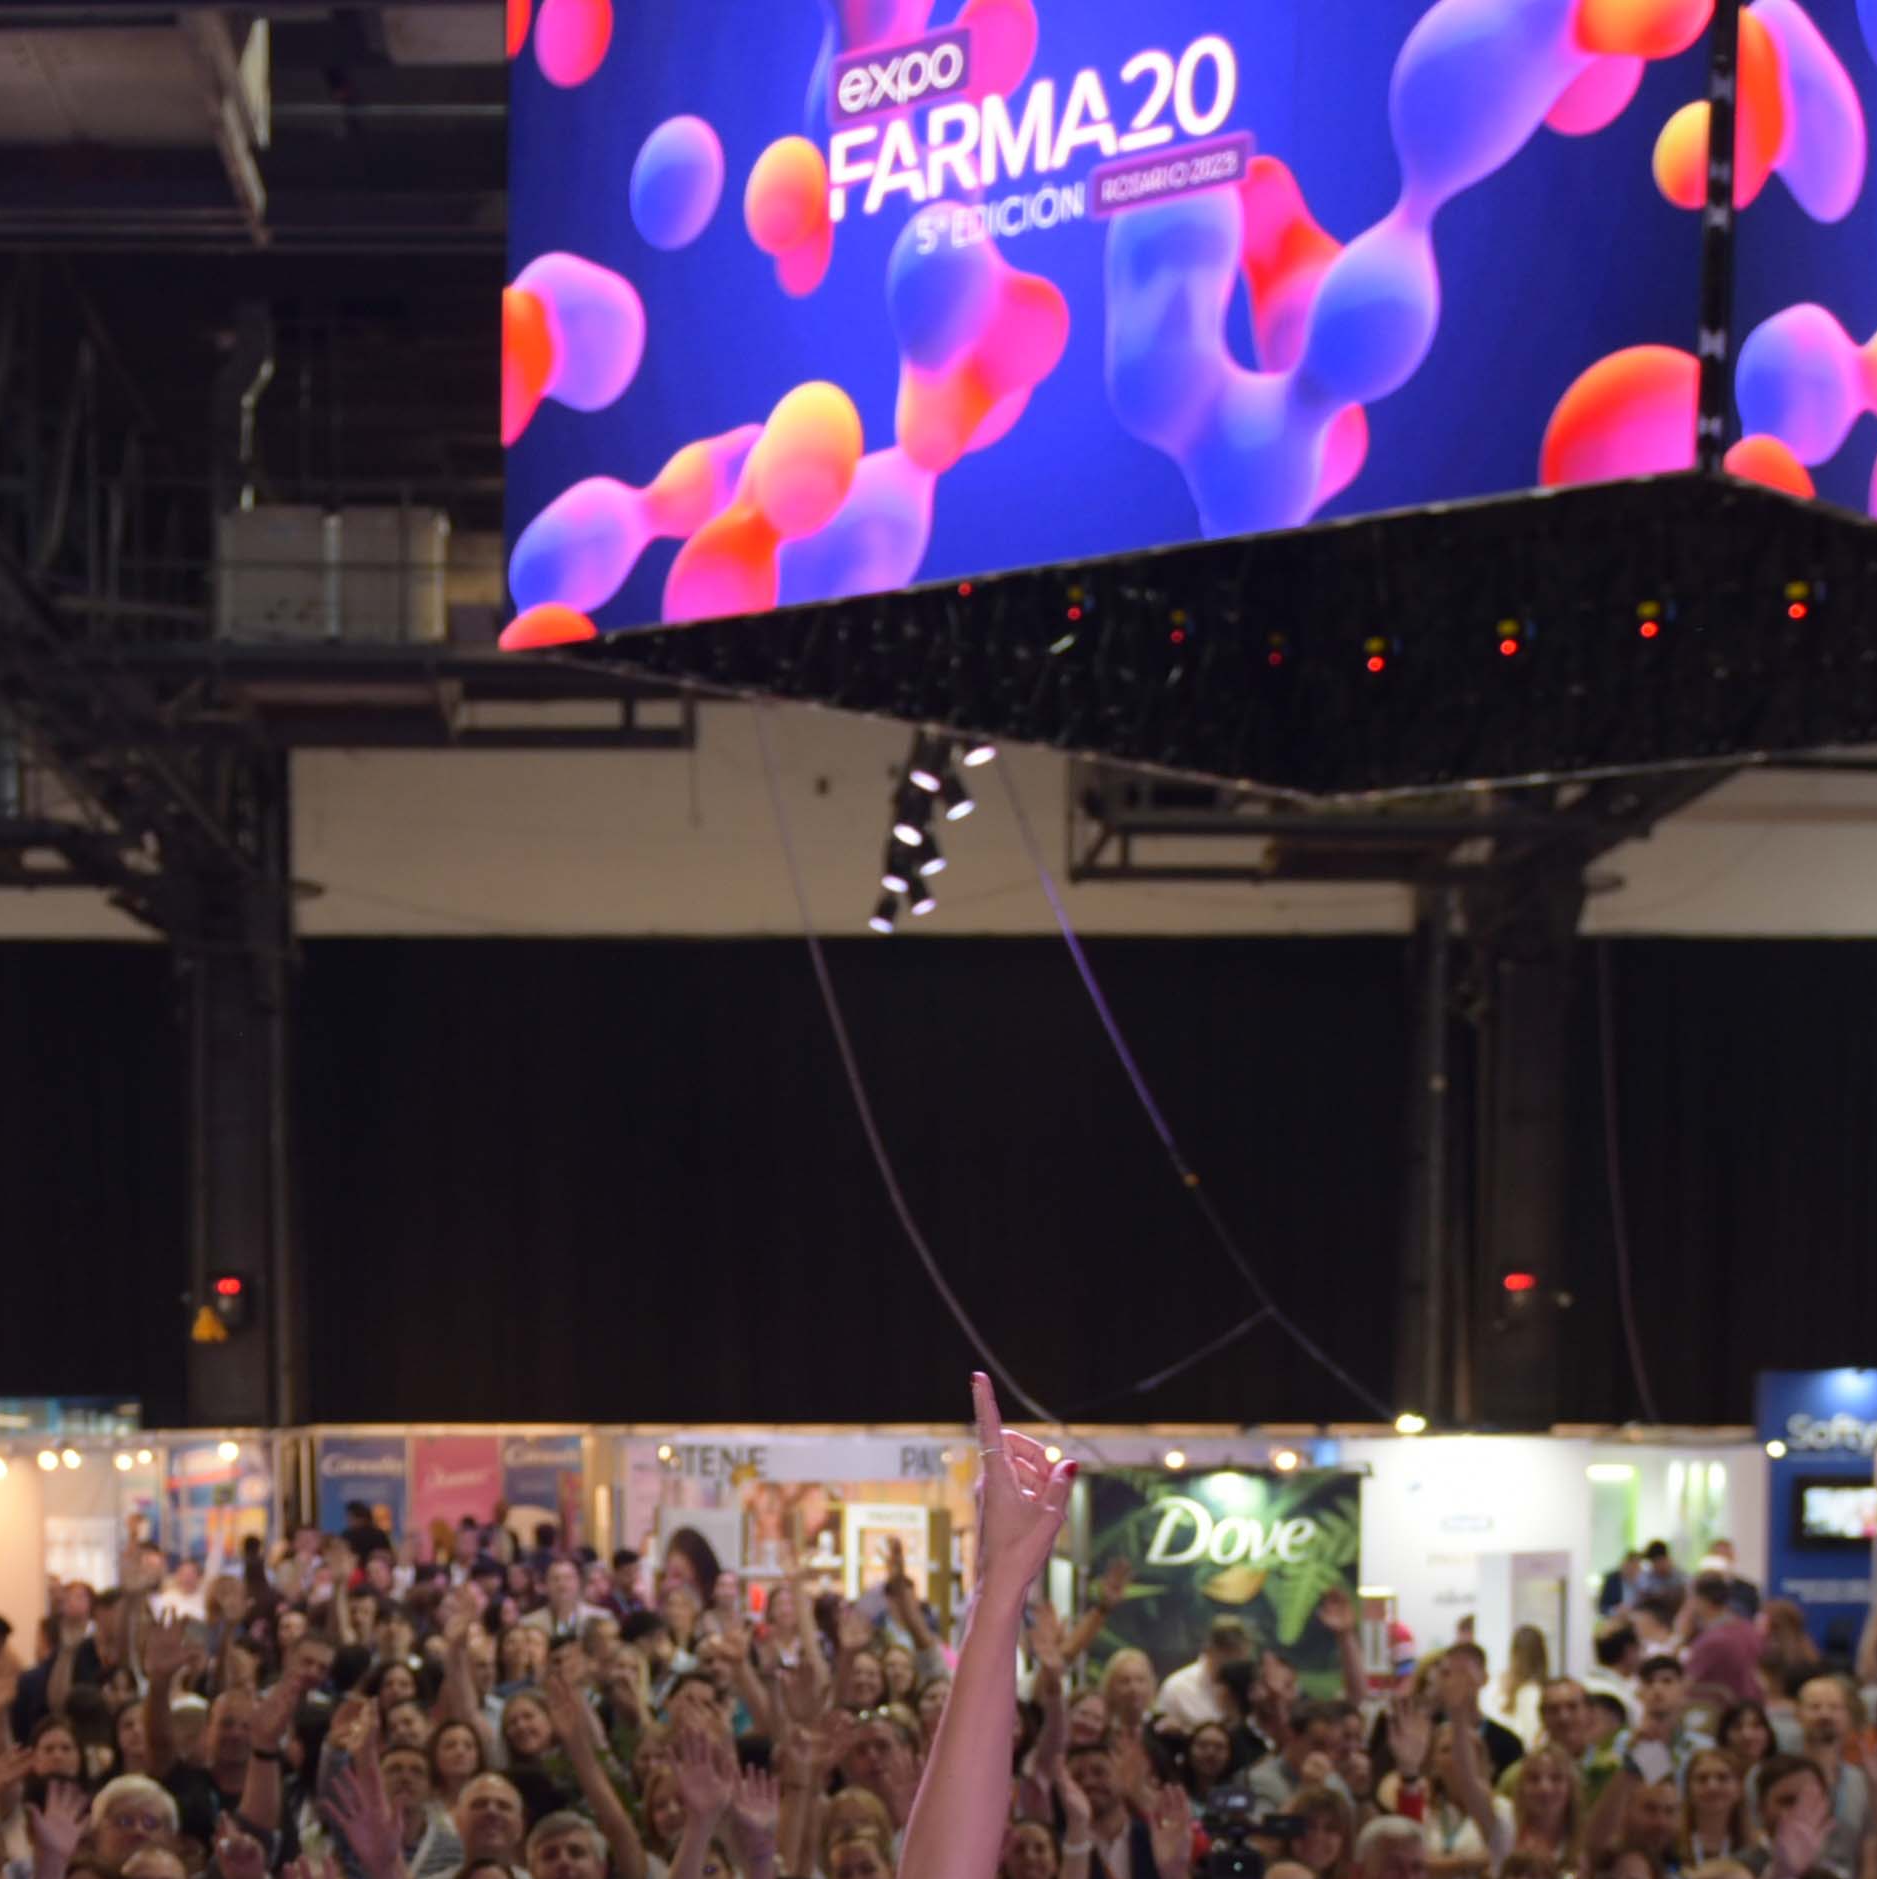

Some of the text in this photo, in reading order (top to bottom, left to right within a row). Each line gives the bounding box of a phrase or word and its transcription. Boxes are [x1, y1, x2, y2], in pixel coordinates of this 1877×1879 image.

[837, 43, 964, 113] expo
[828, 34, 1238, 223] FARMA20
[1146, 1496, 1317, 1566] Dove
